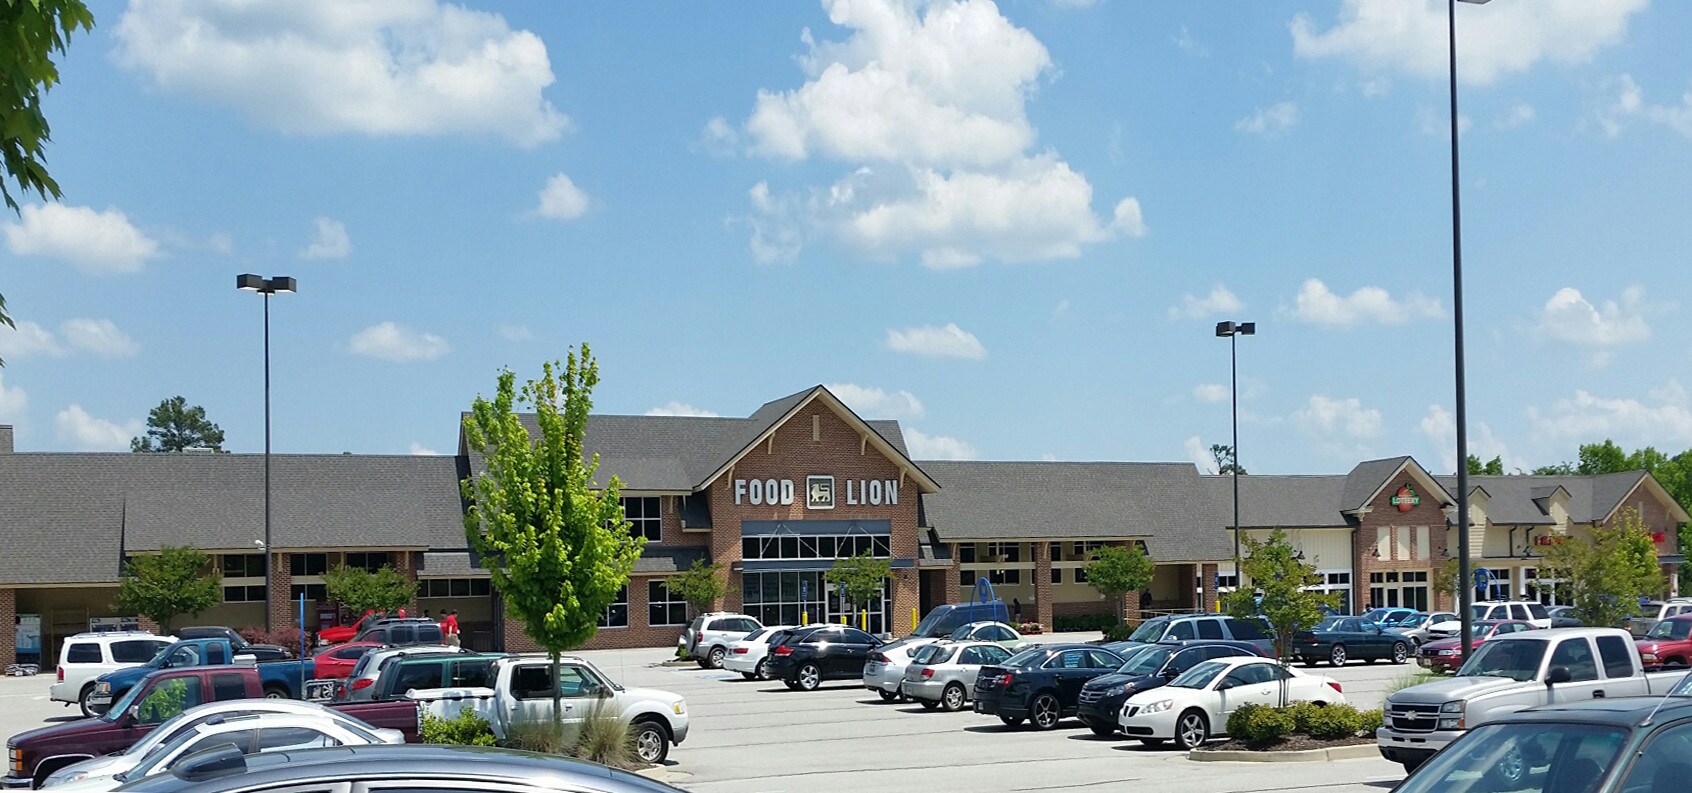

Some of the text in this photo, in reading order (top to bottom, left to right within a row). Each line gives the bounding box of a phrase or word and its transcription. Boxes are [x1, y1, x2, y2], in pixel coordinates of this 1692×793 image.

[734, 479, 898, 505] FOOD LION
[1391, 496, 1419, 505] LOTTERY
